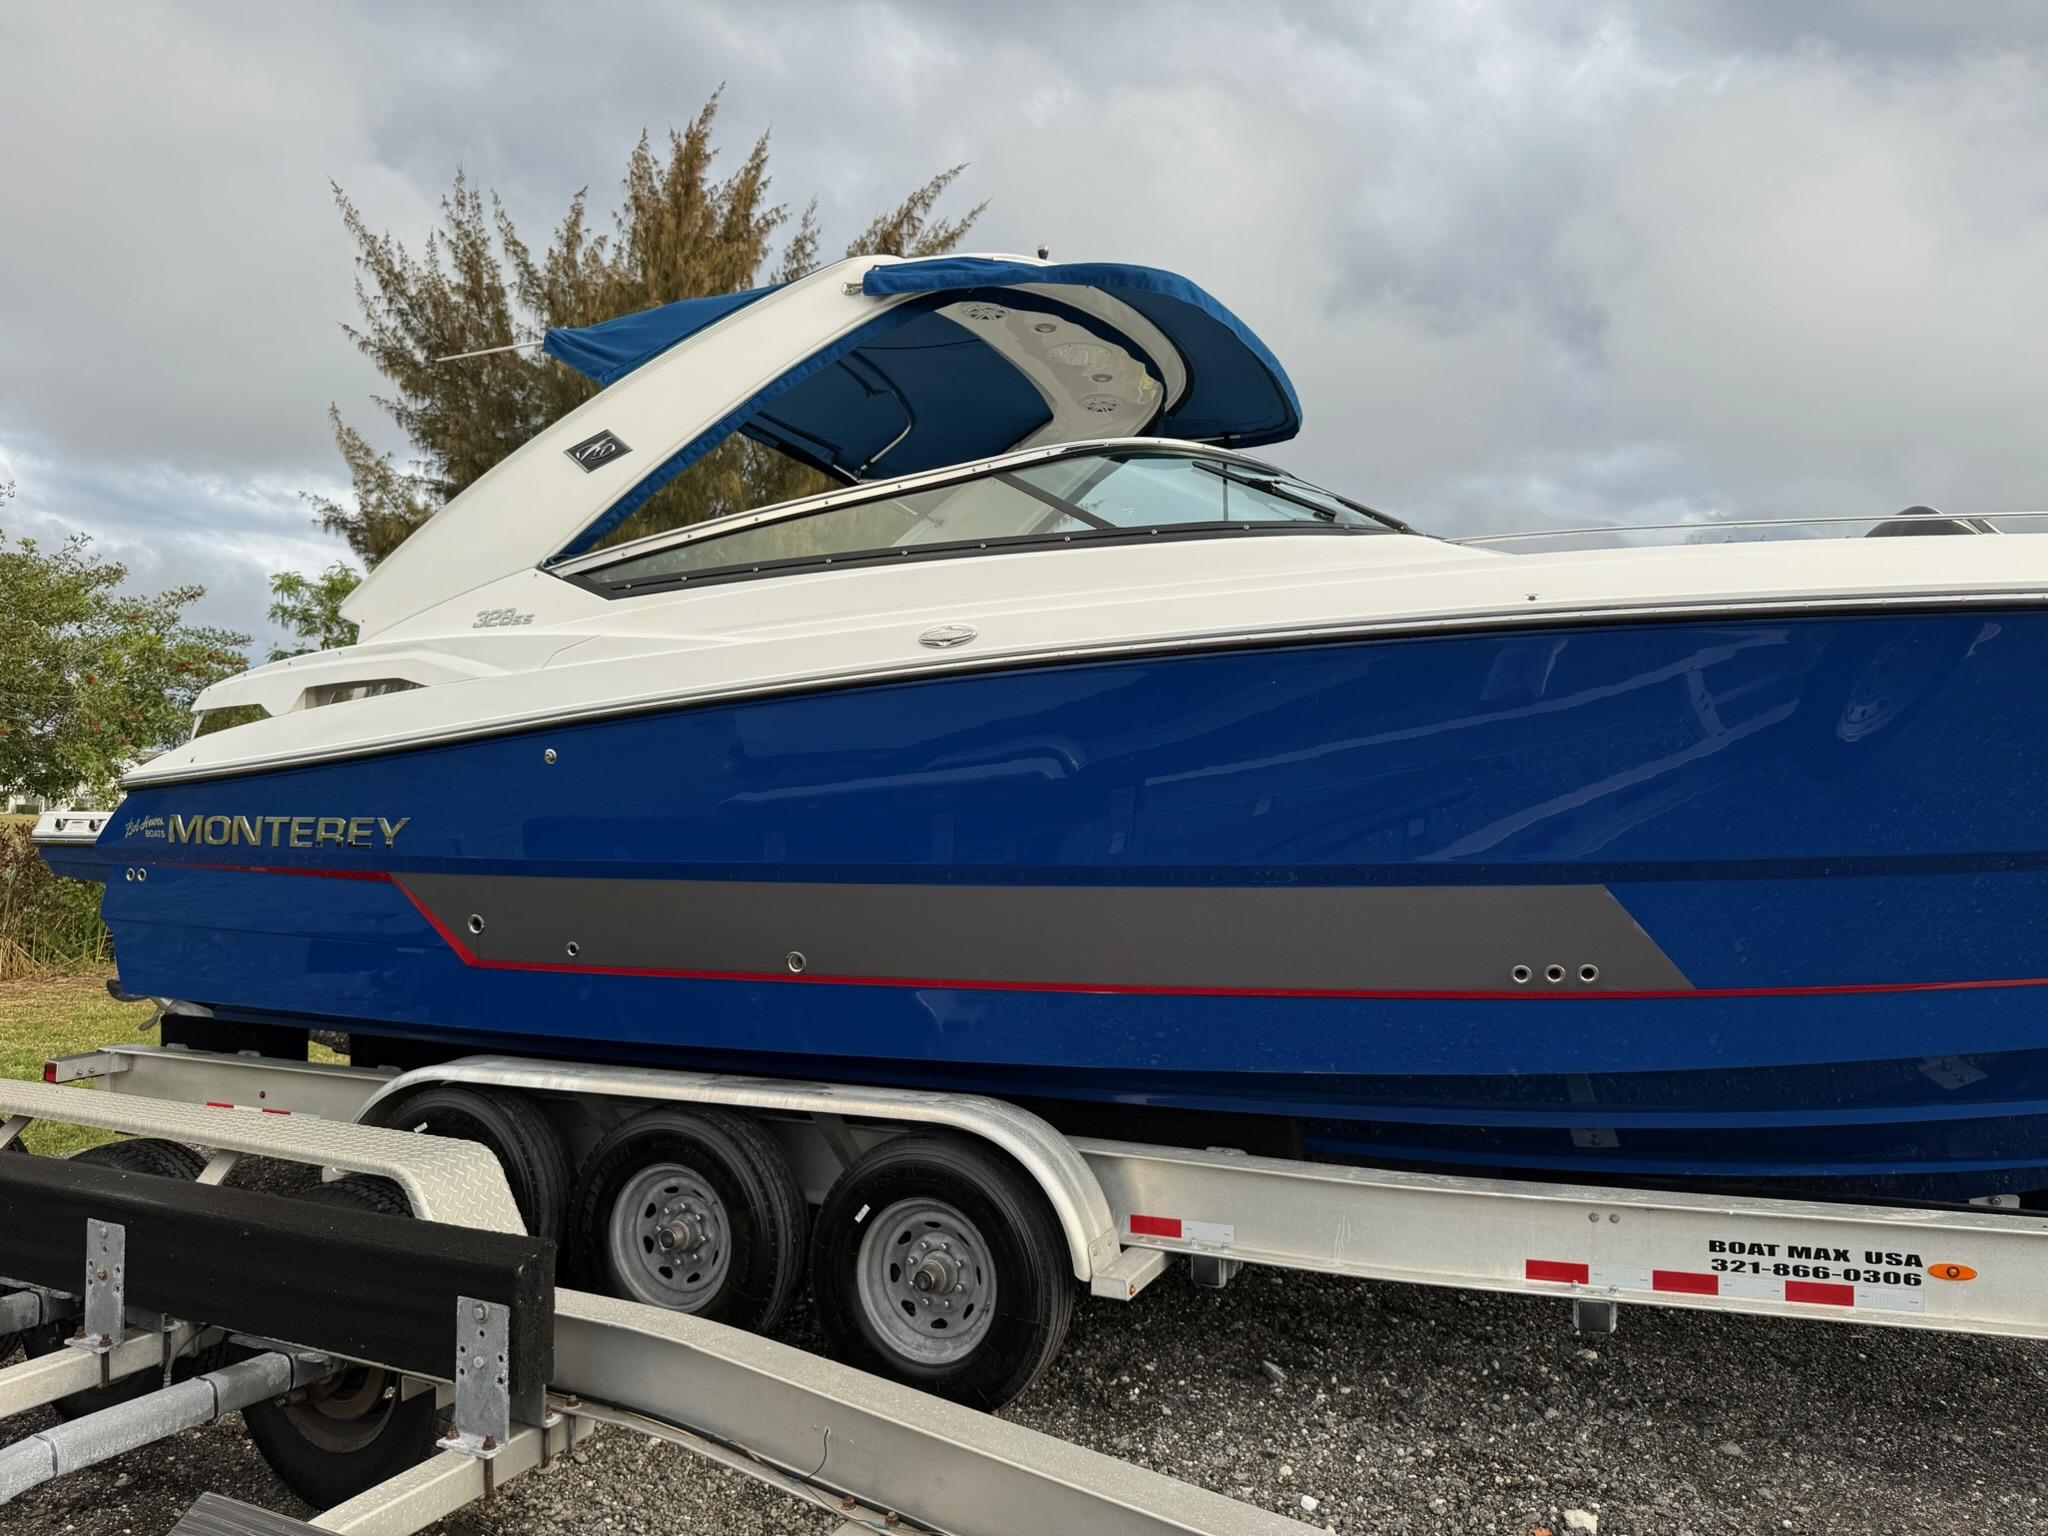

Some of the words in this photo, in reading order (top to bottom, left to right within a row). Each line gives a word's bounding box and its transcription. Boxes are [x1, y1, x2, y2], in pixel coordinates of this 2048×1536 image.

[124, 817, 141, 839] Bob
[145, 829, 166, 839] BOATS
[167, 814, 411, 848] MONTEREY
[1709, 1239, 1780, 1257] BOAT
[1787, 1245, 1851, 1263] MAX
[1864, 1251, 1924, 1268] USA
[1710, 1258, 1923, 1287] 321-866-0306
